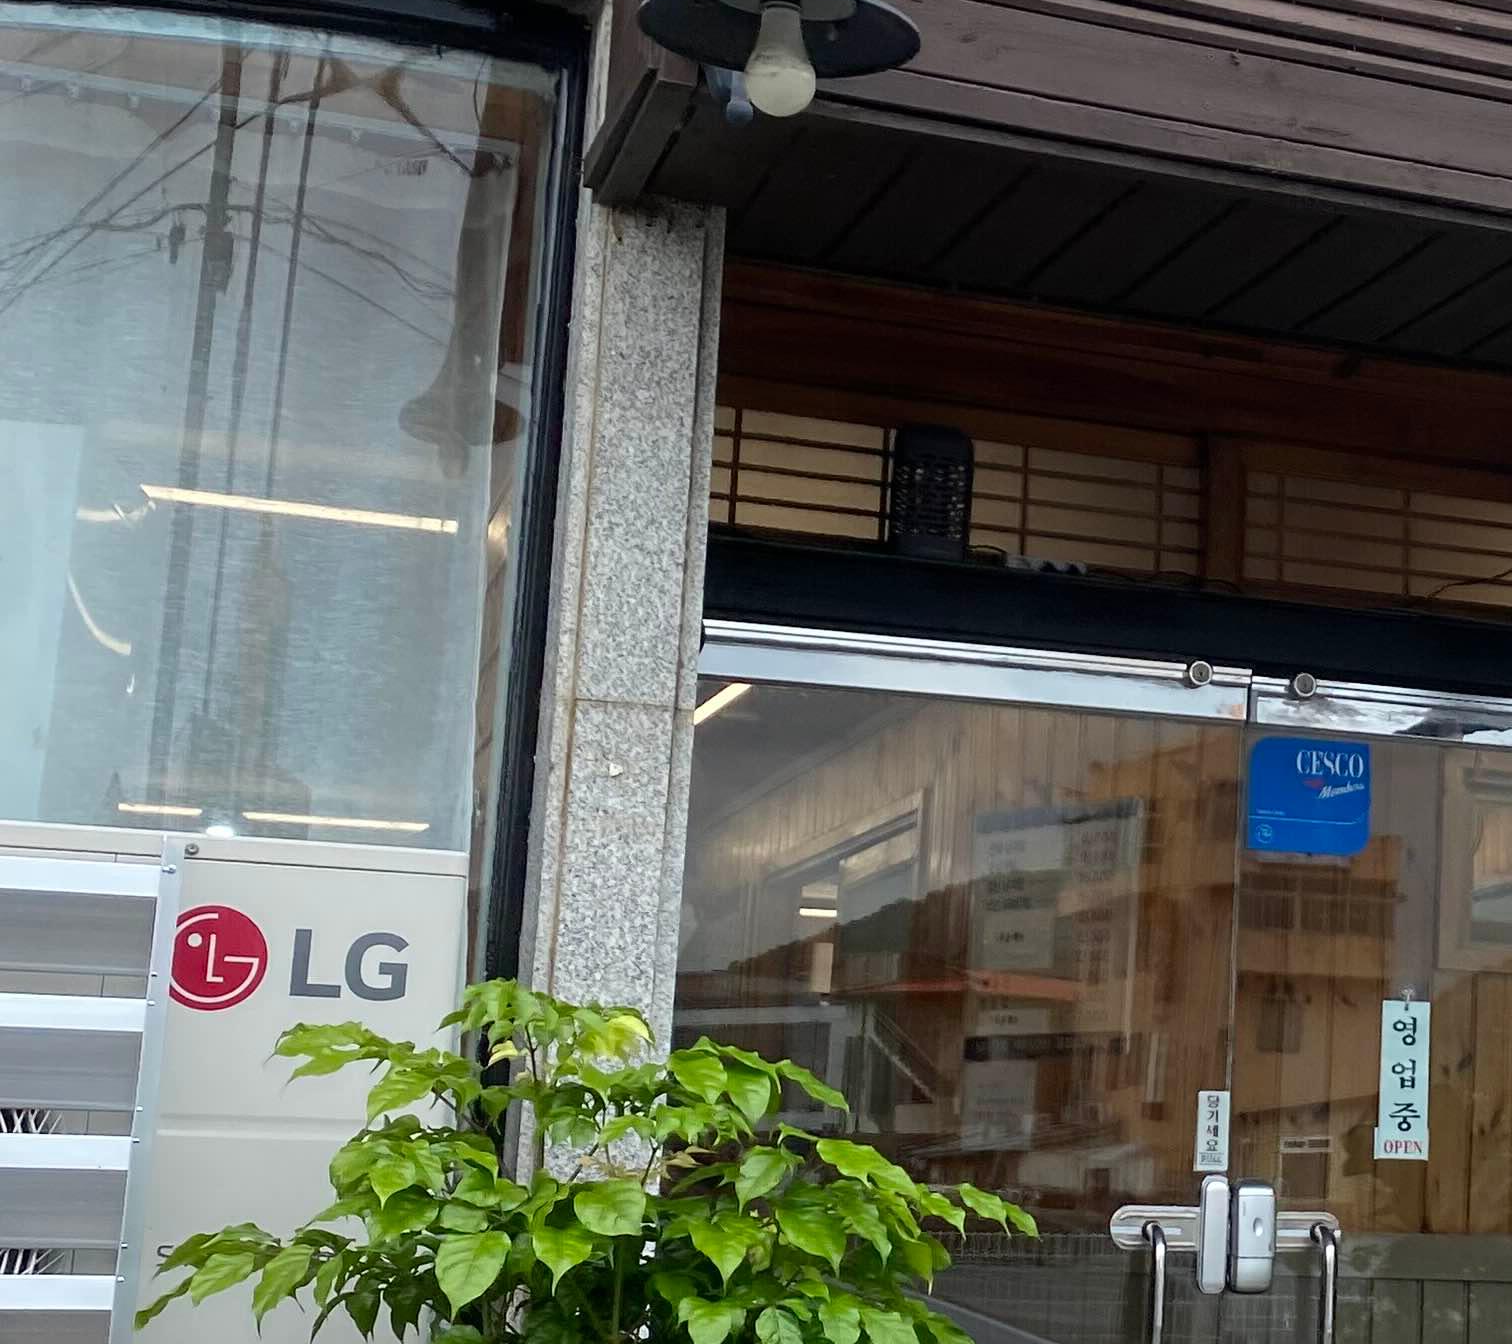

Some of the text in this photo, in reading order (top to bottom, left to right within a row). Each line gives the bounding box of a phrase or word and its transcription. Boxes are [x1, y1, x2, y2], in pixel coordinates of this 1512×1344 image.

[1296, 750, 1363, 778] CESCO
[289, 928, 409, 1001] LG
[1389, 1016, 1421, 1132] 영업중
[1206, 1095, 1220, 1152] 당기세요
[1383, 1139, 1423, 1155] OPEN
